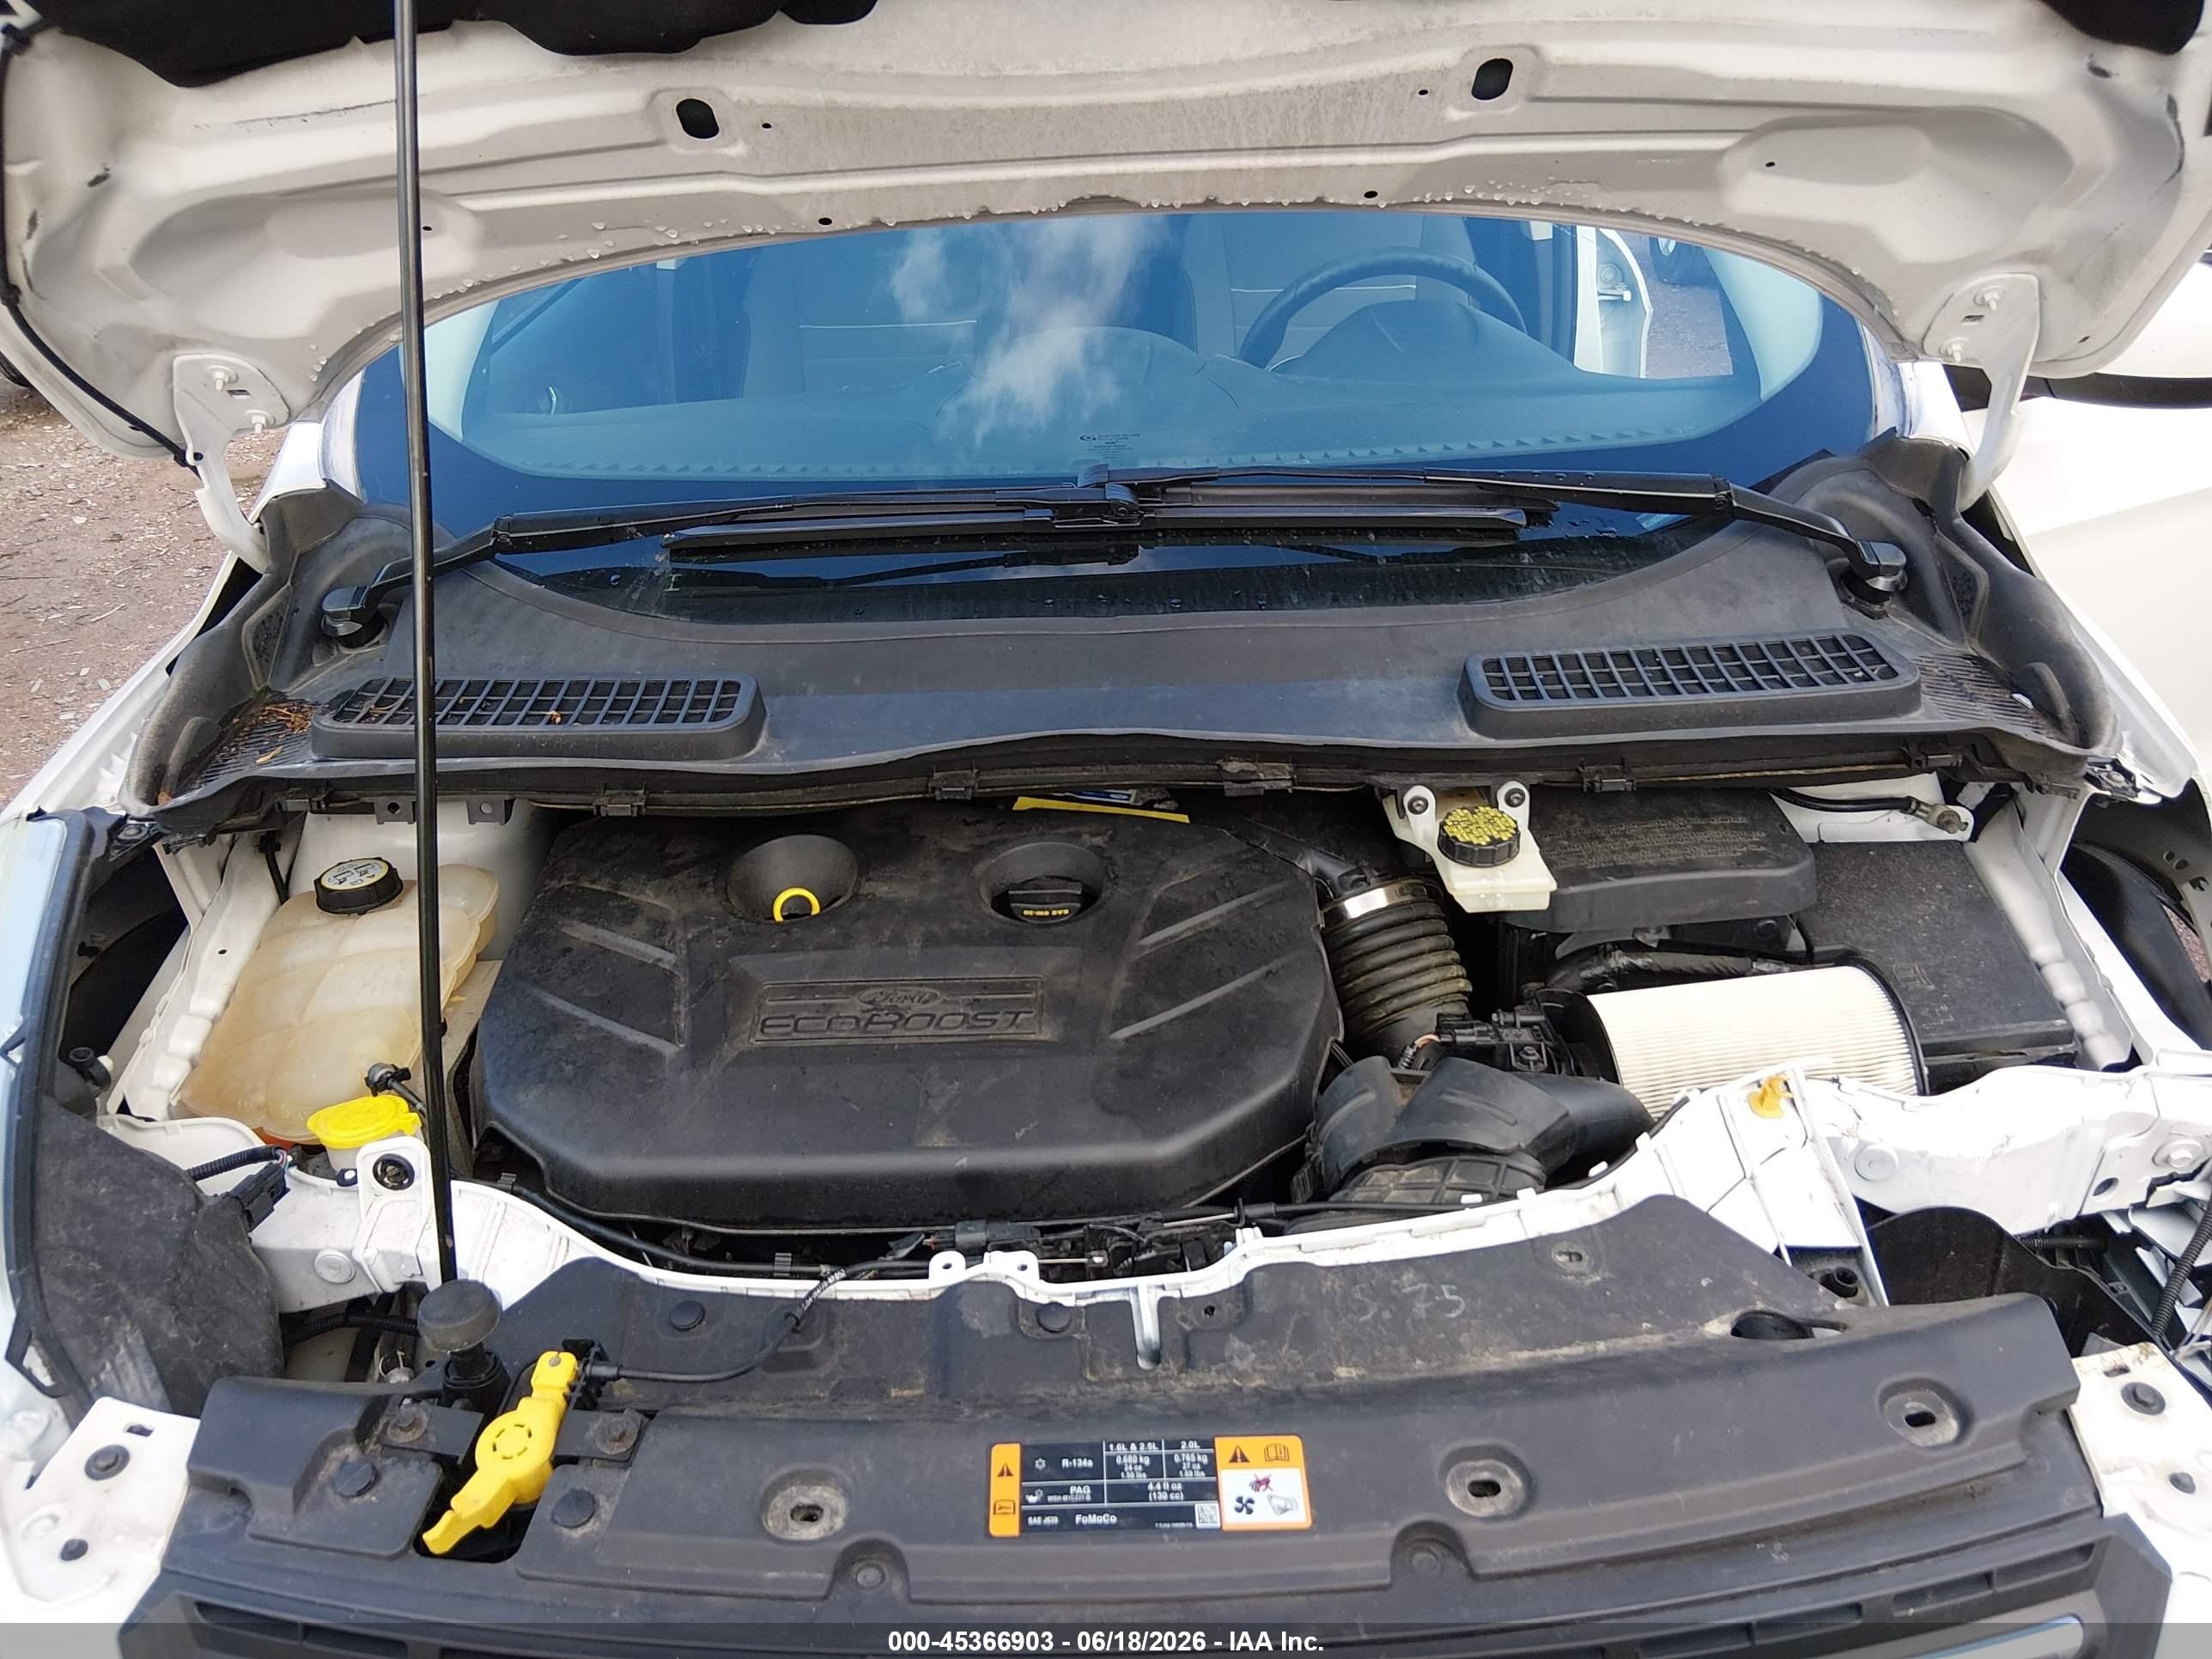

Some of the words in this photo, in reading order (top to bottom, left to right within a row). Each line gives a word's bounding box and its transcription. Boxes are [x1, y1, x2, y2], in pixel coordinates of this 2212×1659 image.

[1181, 1441, 1200, 1449] 2.0L
[1061, 1457, 1093, 1468] R-134a
[1070, 1486, 1091, 1494] PAG
[1148, 1492, 1168, 1501] (130
[1170, 1491, 1184, 1501] cc)
[1075, 1513, 1117, 1525] FoMoCo
